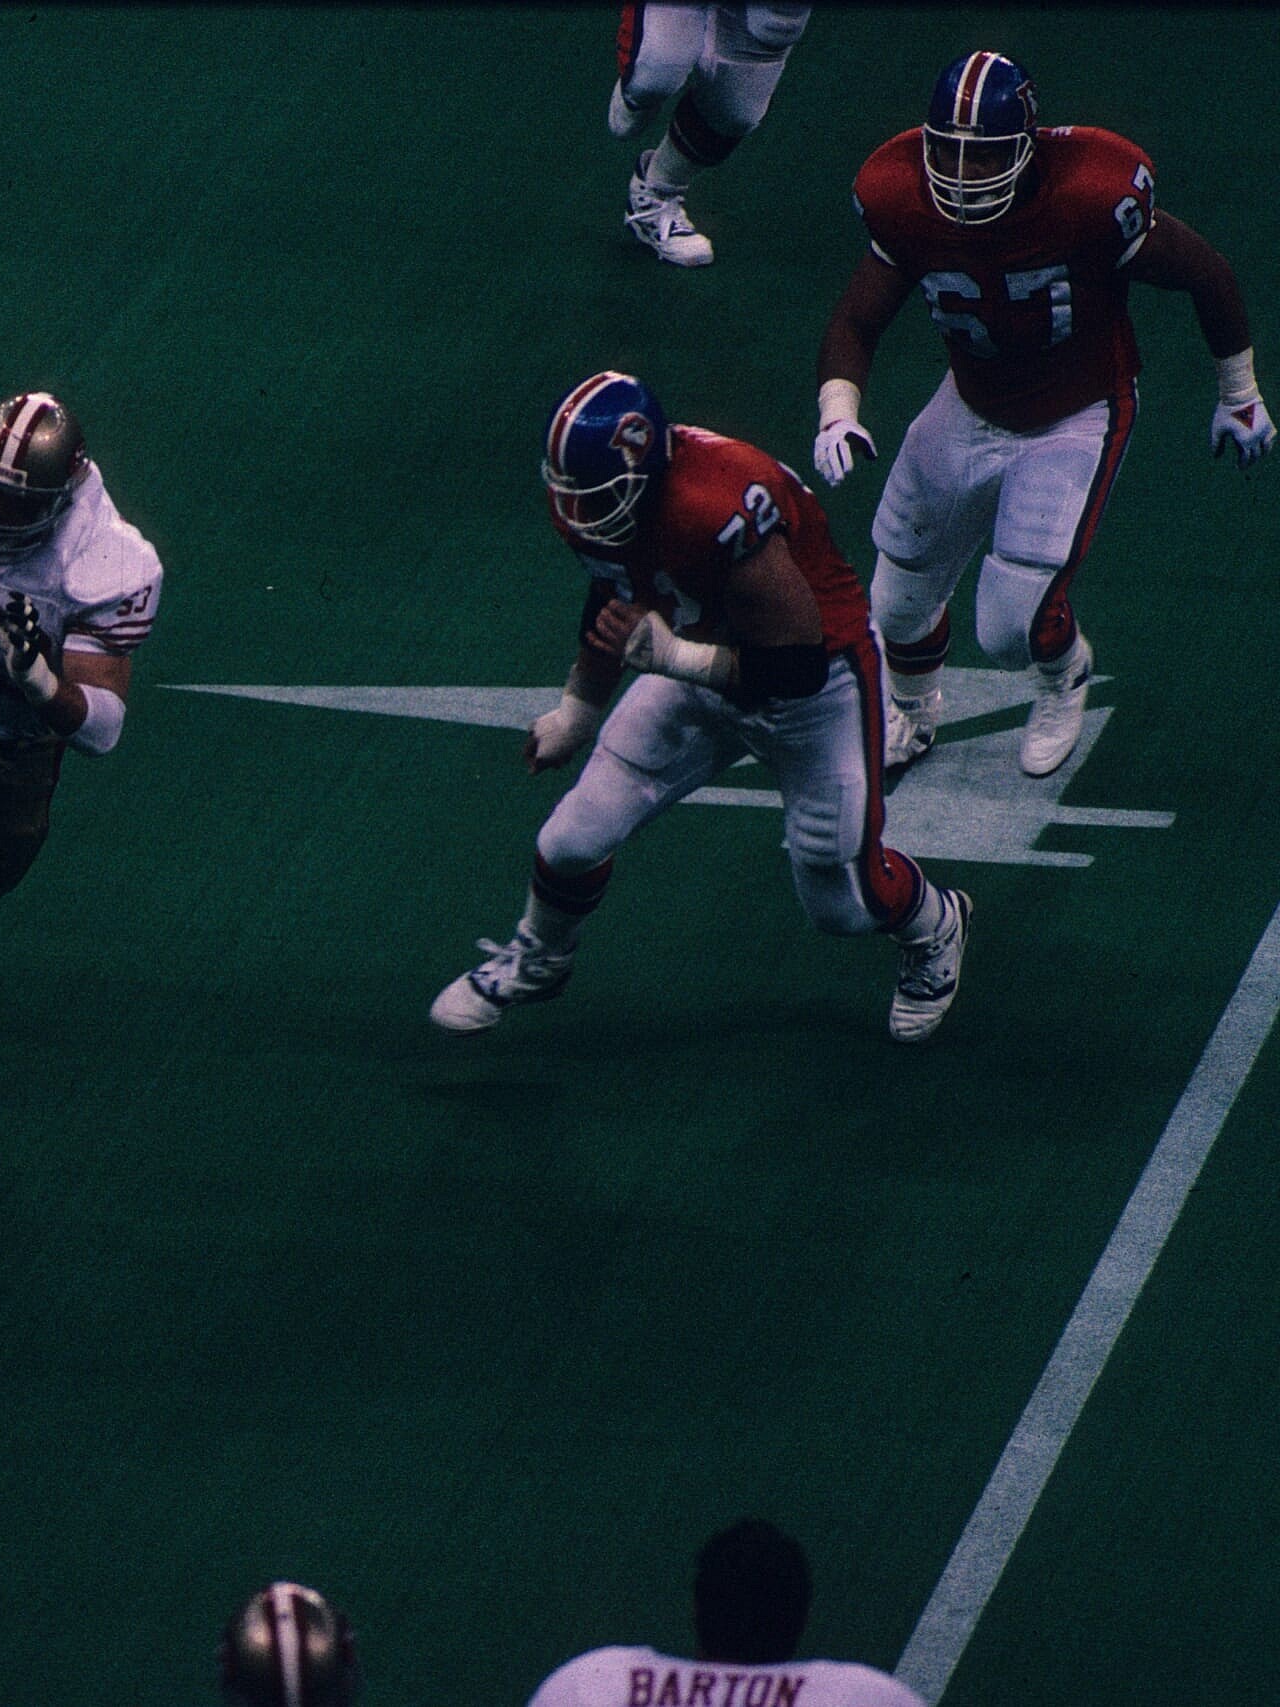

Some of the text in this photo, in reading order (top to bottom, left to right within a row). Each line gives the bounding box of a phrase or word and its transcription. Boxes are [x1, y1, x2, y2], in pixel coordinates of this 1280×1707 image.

[919, 263, 1074, 361] 67
[716, 483, 781, 561] 72
[629, 1667, 805, 1707] BARTON
